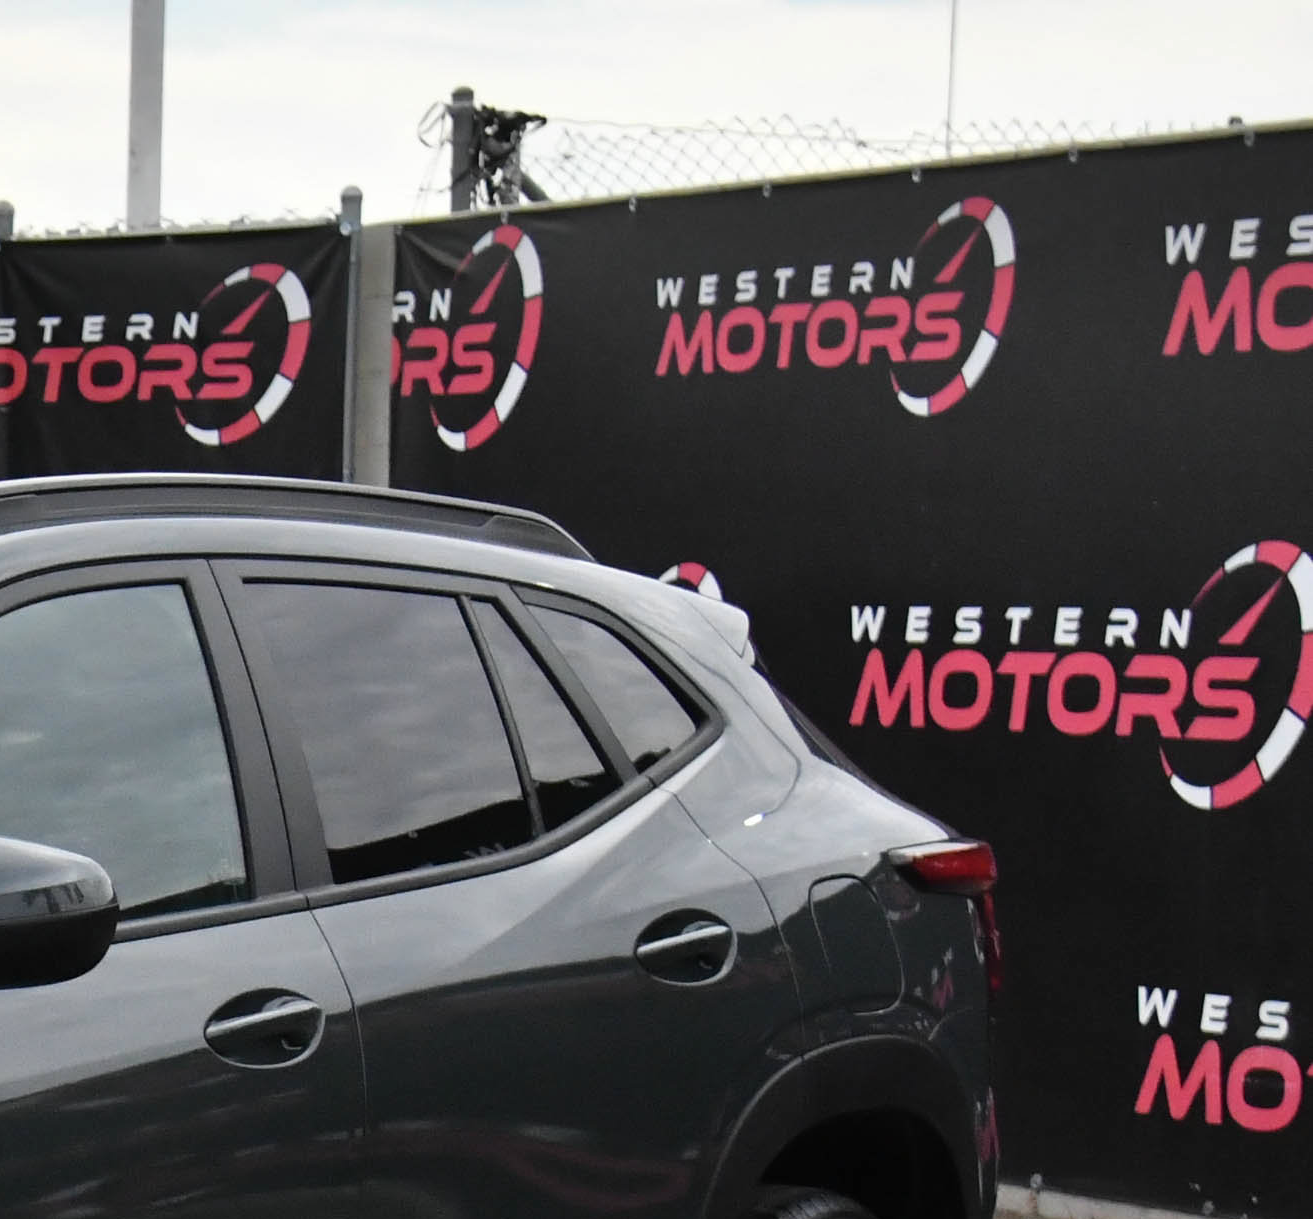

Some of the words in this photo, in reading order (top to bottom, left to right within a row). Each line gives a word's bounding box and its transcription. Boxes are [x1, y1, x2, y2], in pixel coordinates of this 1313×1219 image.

[656, 256, 915, 309] WESTERN
[655, 291, 965, 376] MOTORS
[850, 605, 1192, 649] WESTERN
[848, 648, 1260, 741] MOTORS
